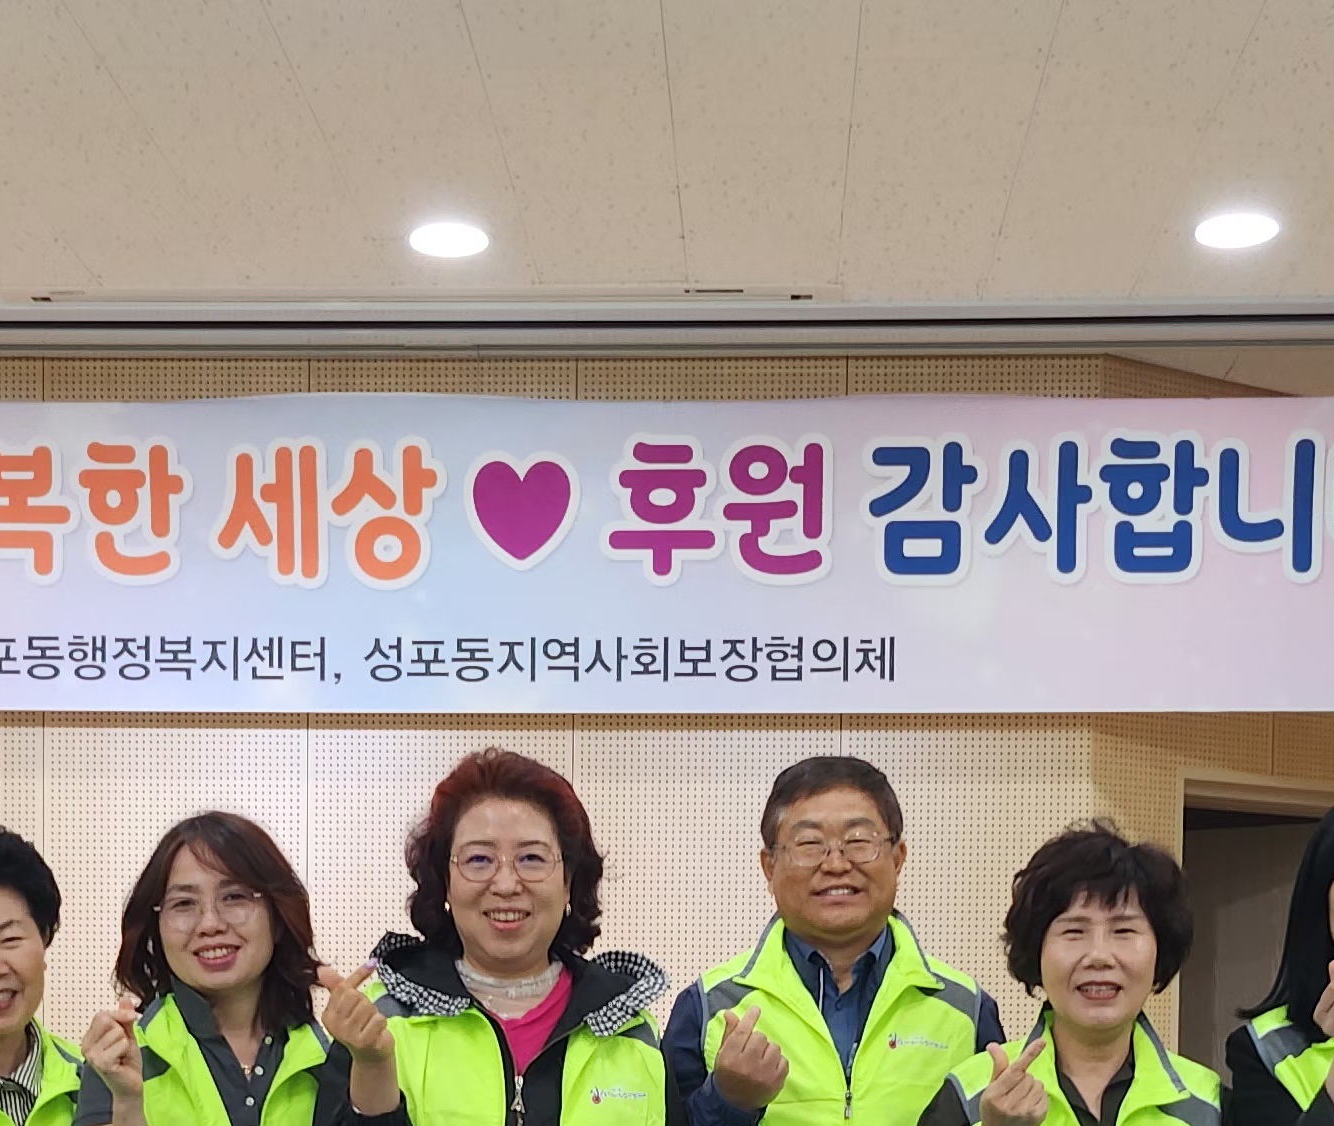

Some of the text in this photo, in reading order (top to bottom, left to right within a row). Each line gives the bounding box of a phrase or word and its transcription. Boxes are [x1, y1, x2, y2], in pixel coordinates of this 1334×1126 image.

[217, 444, 439, 581] 세상
[608, 442, 824, 578] 후원
[363, 635, 897, 684] 성포동지역사회보장협의체
